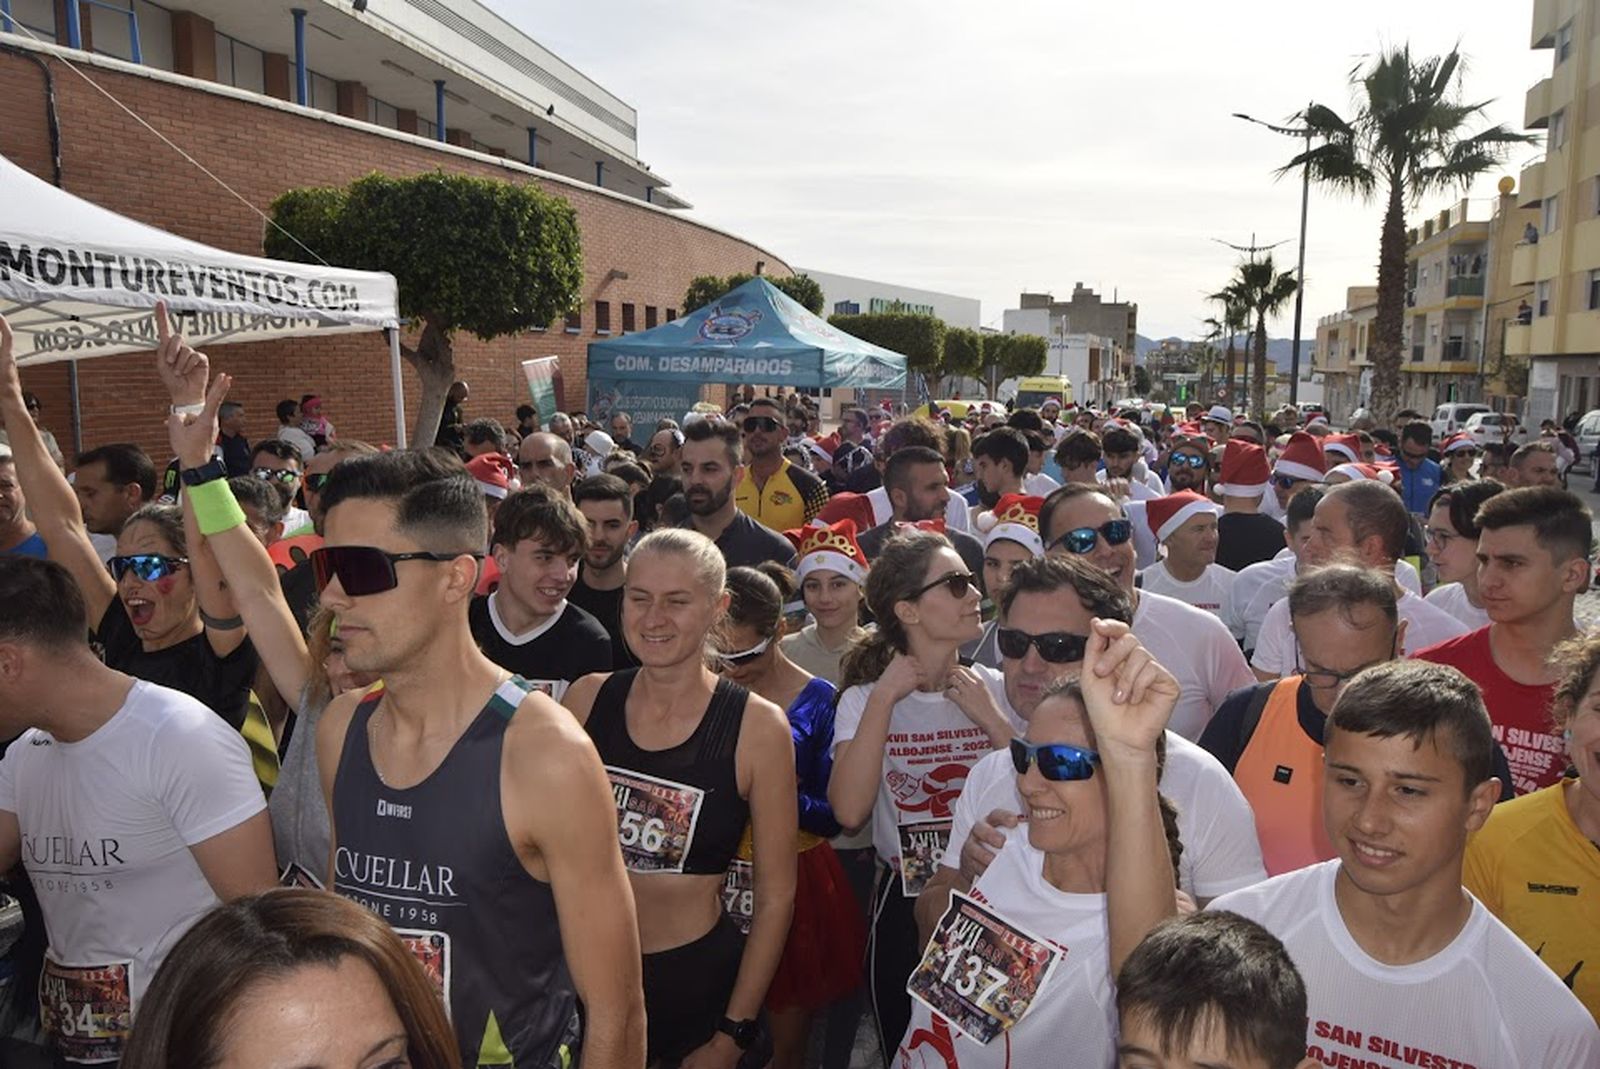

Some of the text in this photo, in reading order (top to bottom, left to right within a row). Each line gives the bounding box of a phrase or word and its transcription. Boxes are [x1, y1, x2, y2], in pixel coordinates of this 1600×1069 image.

[0, 241, 359, 312] MONTUREVENTOS.COM
[614, 355, 794, 375] CDM. DESAMPARADOS
[911, 732, 935, 743] SAN
[335, 847, 458, 897] CUELLAR
[399, 907, 438, 925] 1958
[940, 946, 1009, 1007] 137
[60, 1001, 98, 1037] 34
[1314, 1020, 1362, 1049] SAN
